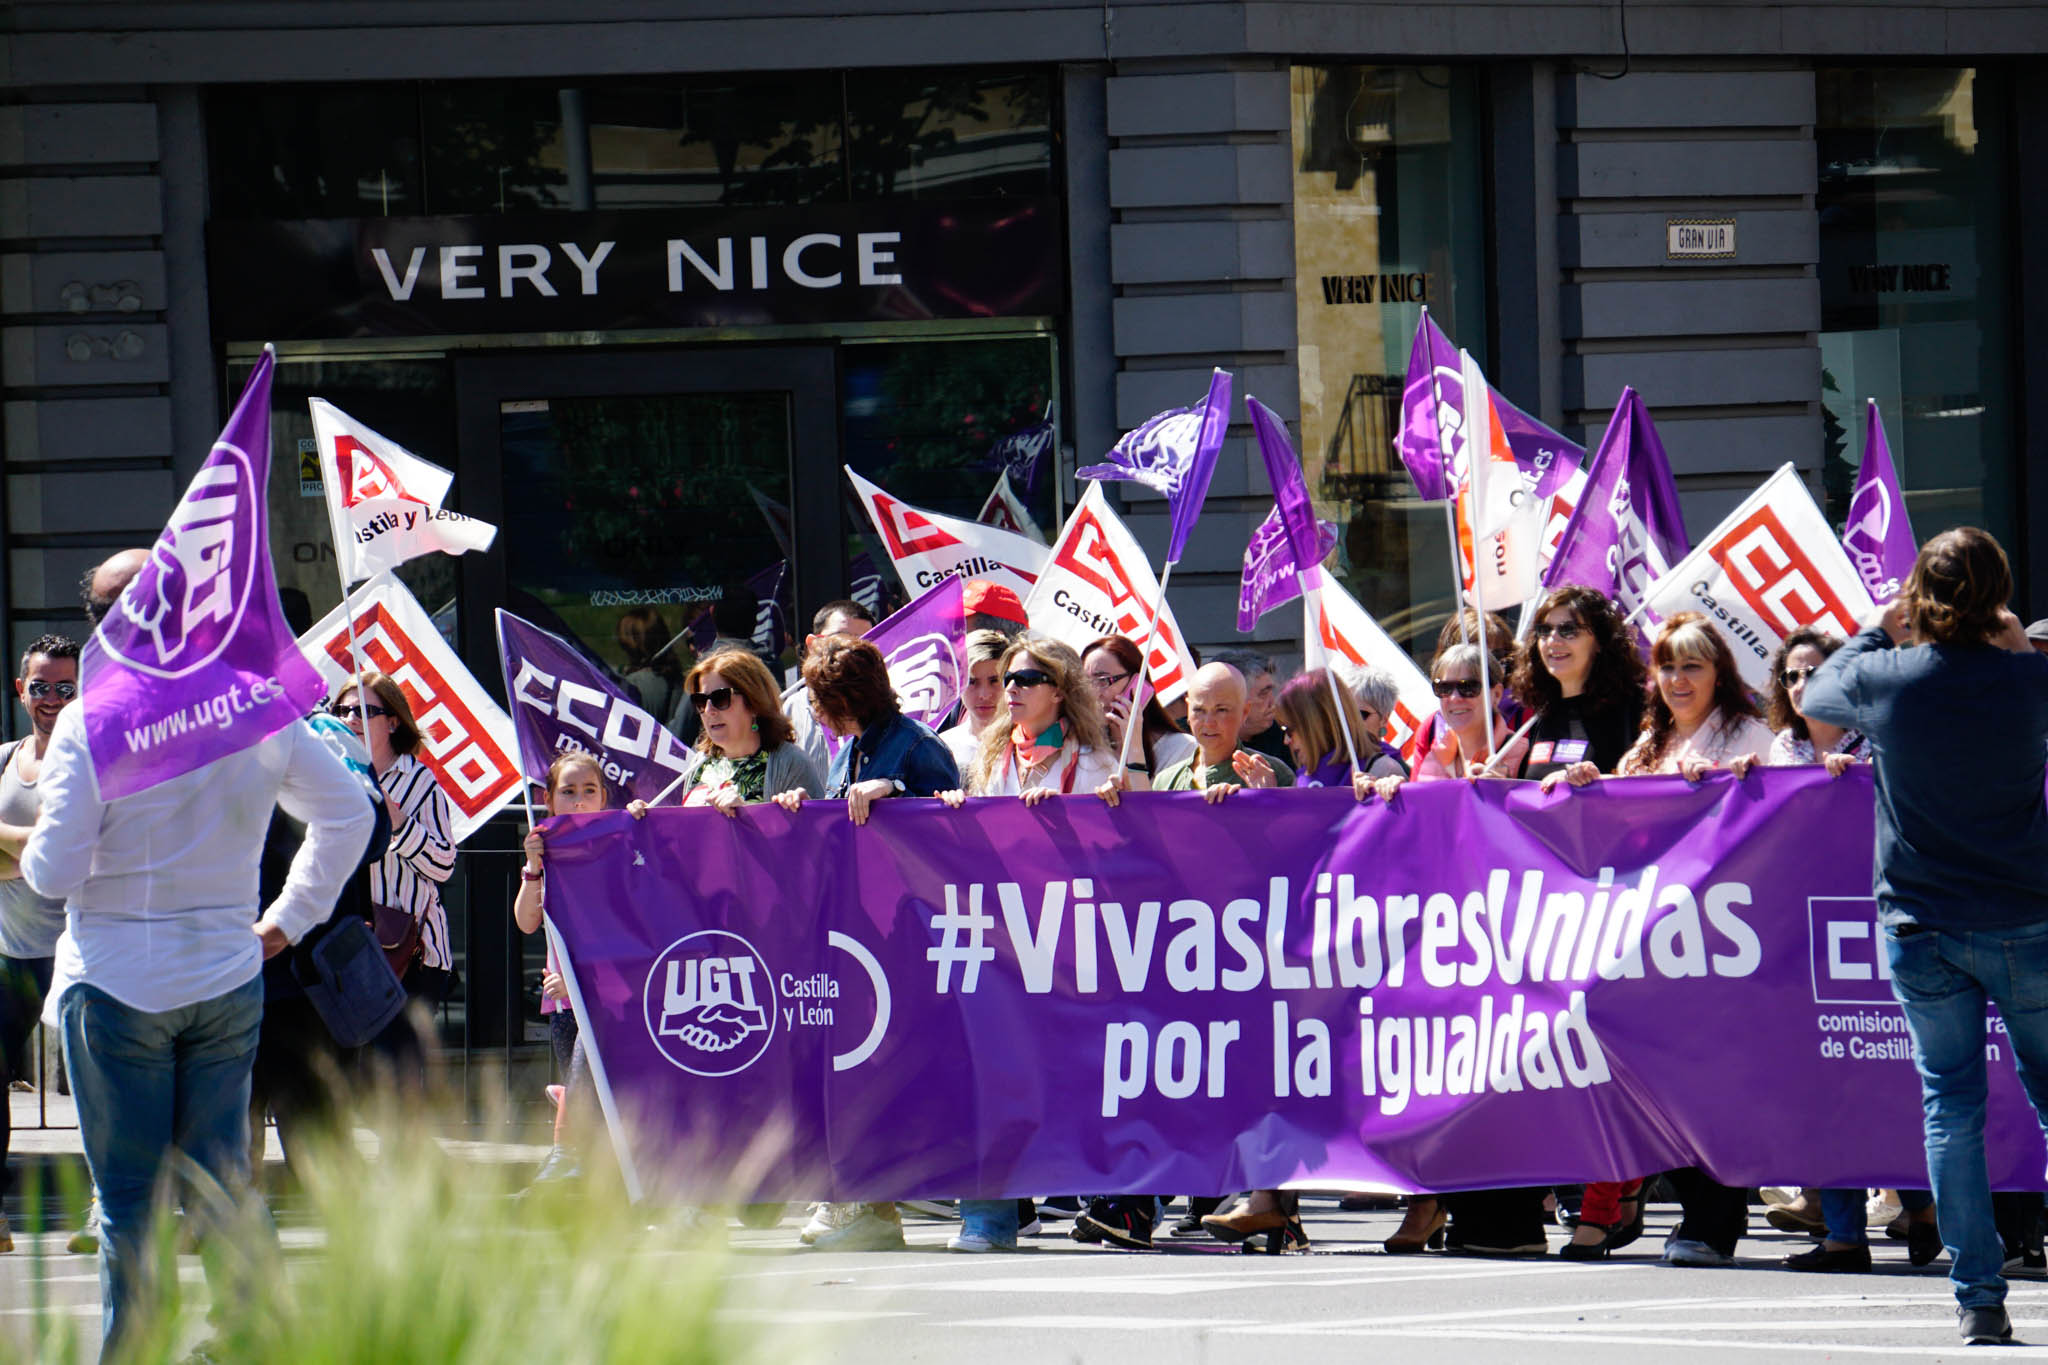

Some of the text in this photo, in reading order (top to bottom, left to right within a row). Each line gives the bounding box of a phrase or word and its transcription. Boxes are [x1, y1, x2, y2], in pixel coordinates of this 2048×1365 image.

[1679, 227, 1704, 249] GRAN
[372, 232, 902, 301] VERY NICE
[1321, 272, 1433, 304] VERY NICE
[1849, 264, 1951, 292] VERY NICE
[404, 511, 418, 530] y
[172, 463, 238, 634] UGT
[1691, 580, 1769, 660] Castilla
[124, 675, 287, 753] www.ugt.es
[344, 620, 502, 800] CCOO
[555, 733, 634, 787] mjer
[927, 864, 1762, 994] #VivasLibresUnidas
[663, 956, 757, 1012] UGT
[780, 972, 840, 999] Castilla
[783, 1000, 834, 1032] y León
[1818, 1010, 1911, 1033] comision
[1101, 991, 1610, 1116] por la igualdad
[1820, 1036, 1845, 1058] de
